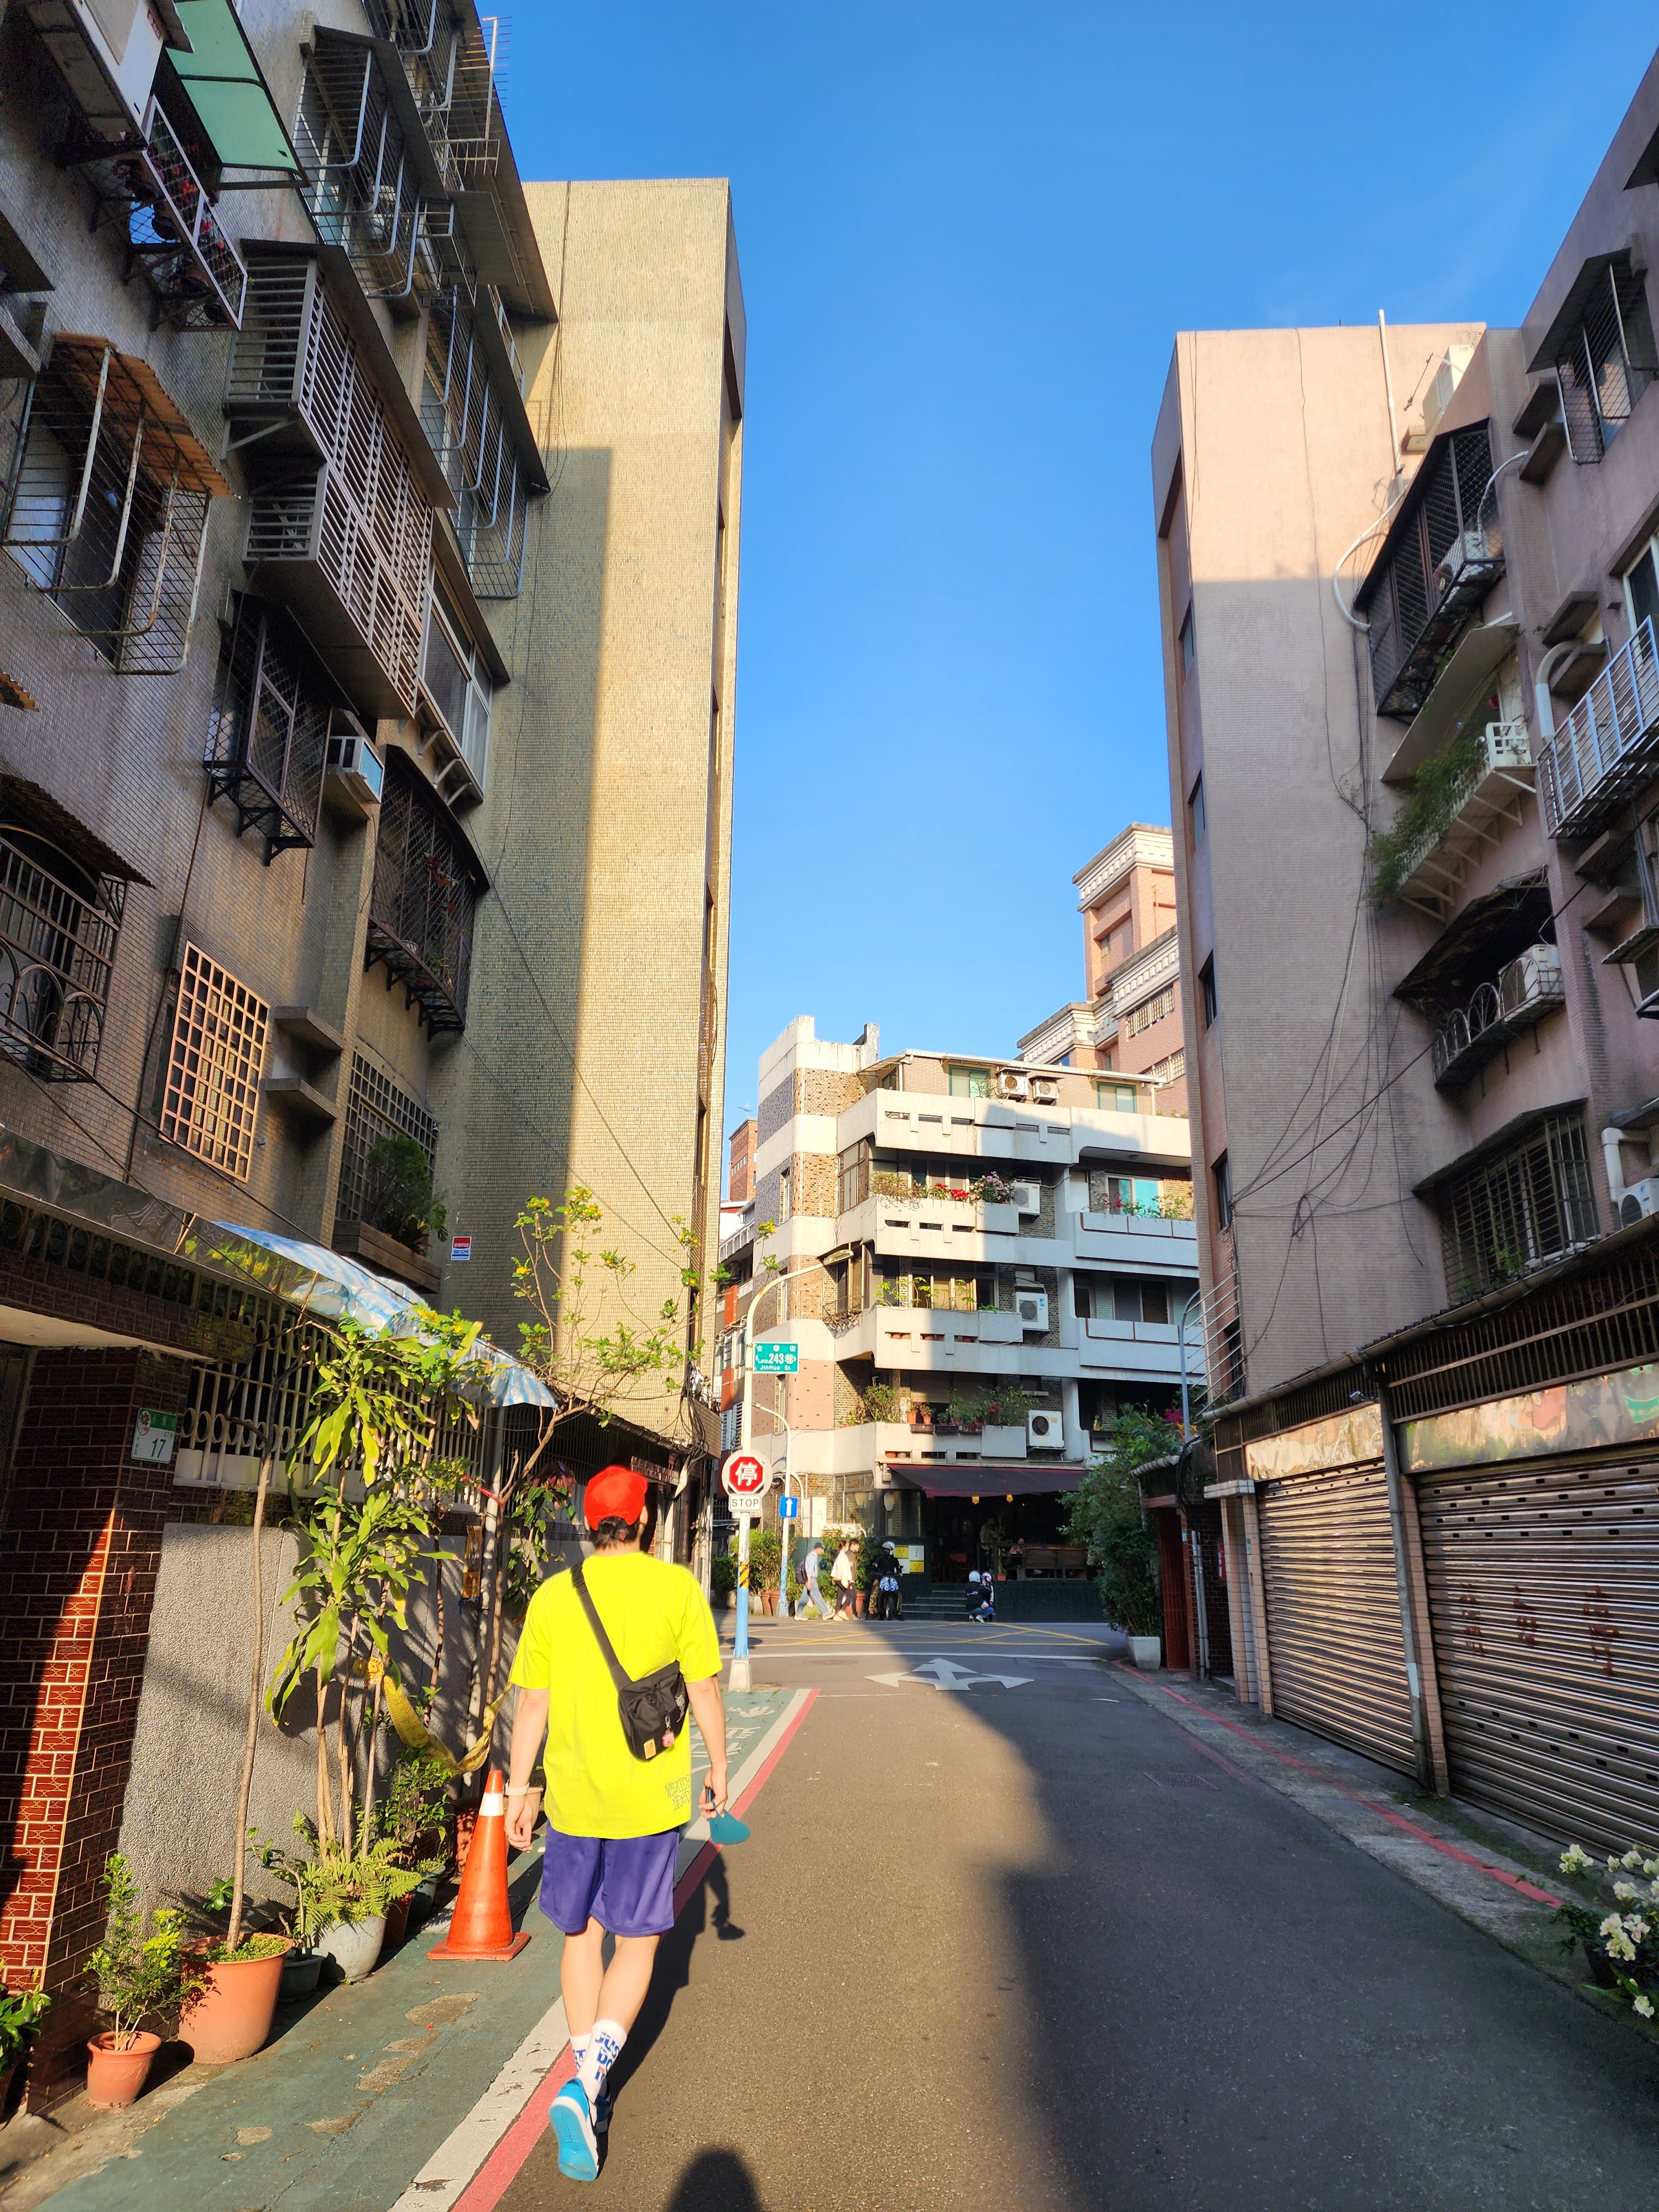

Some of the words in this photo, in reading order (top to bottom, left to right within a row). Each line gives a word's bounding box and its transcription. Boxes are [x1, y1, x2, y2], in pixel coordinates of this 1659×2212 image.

[151, 1438, 166, 1458] 17
[735, 1462, 757, 1486] 停
[732, 1499, 759, 1507] STOP
